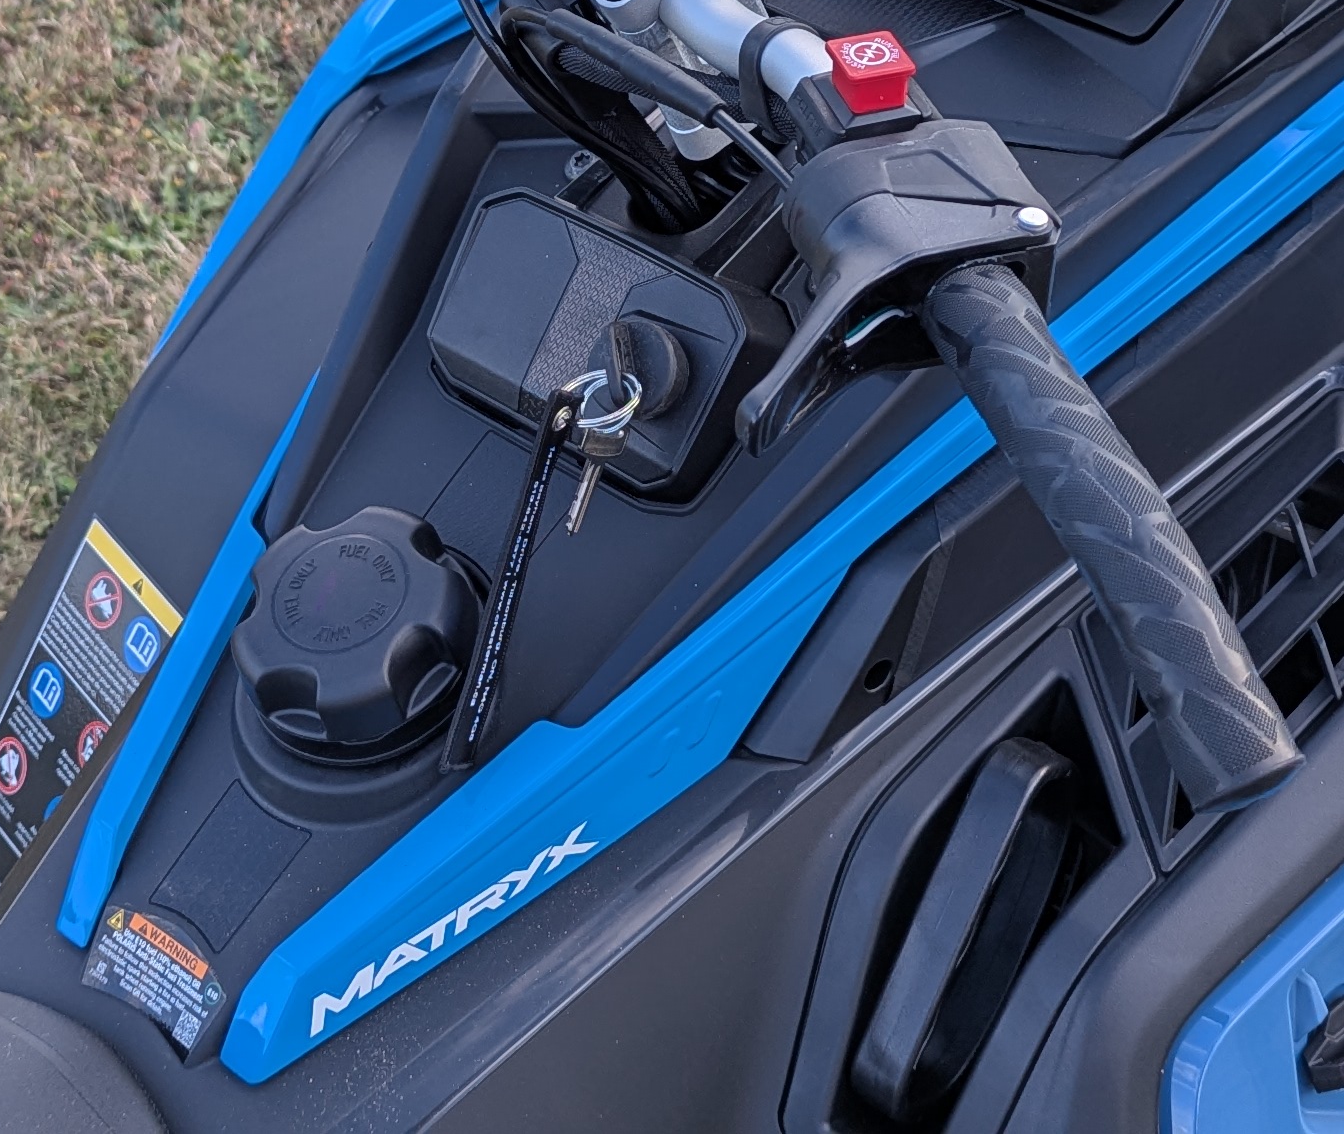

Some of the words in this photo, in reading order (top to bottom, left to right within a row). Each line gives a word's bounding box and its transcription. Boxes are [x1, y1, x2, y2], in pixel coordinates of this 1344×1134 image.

[288, 558, 318, 590] ONLY
[338, 544, 371, 562] FUEL
[372, 554, 396, 583] ONLY
[149, 927, 199, 972] WARNING
[309, 820, 600, 1039] MATRYX
